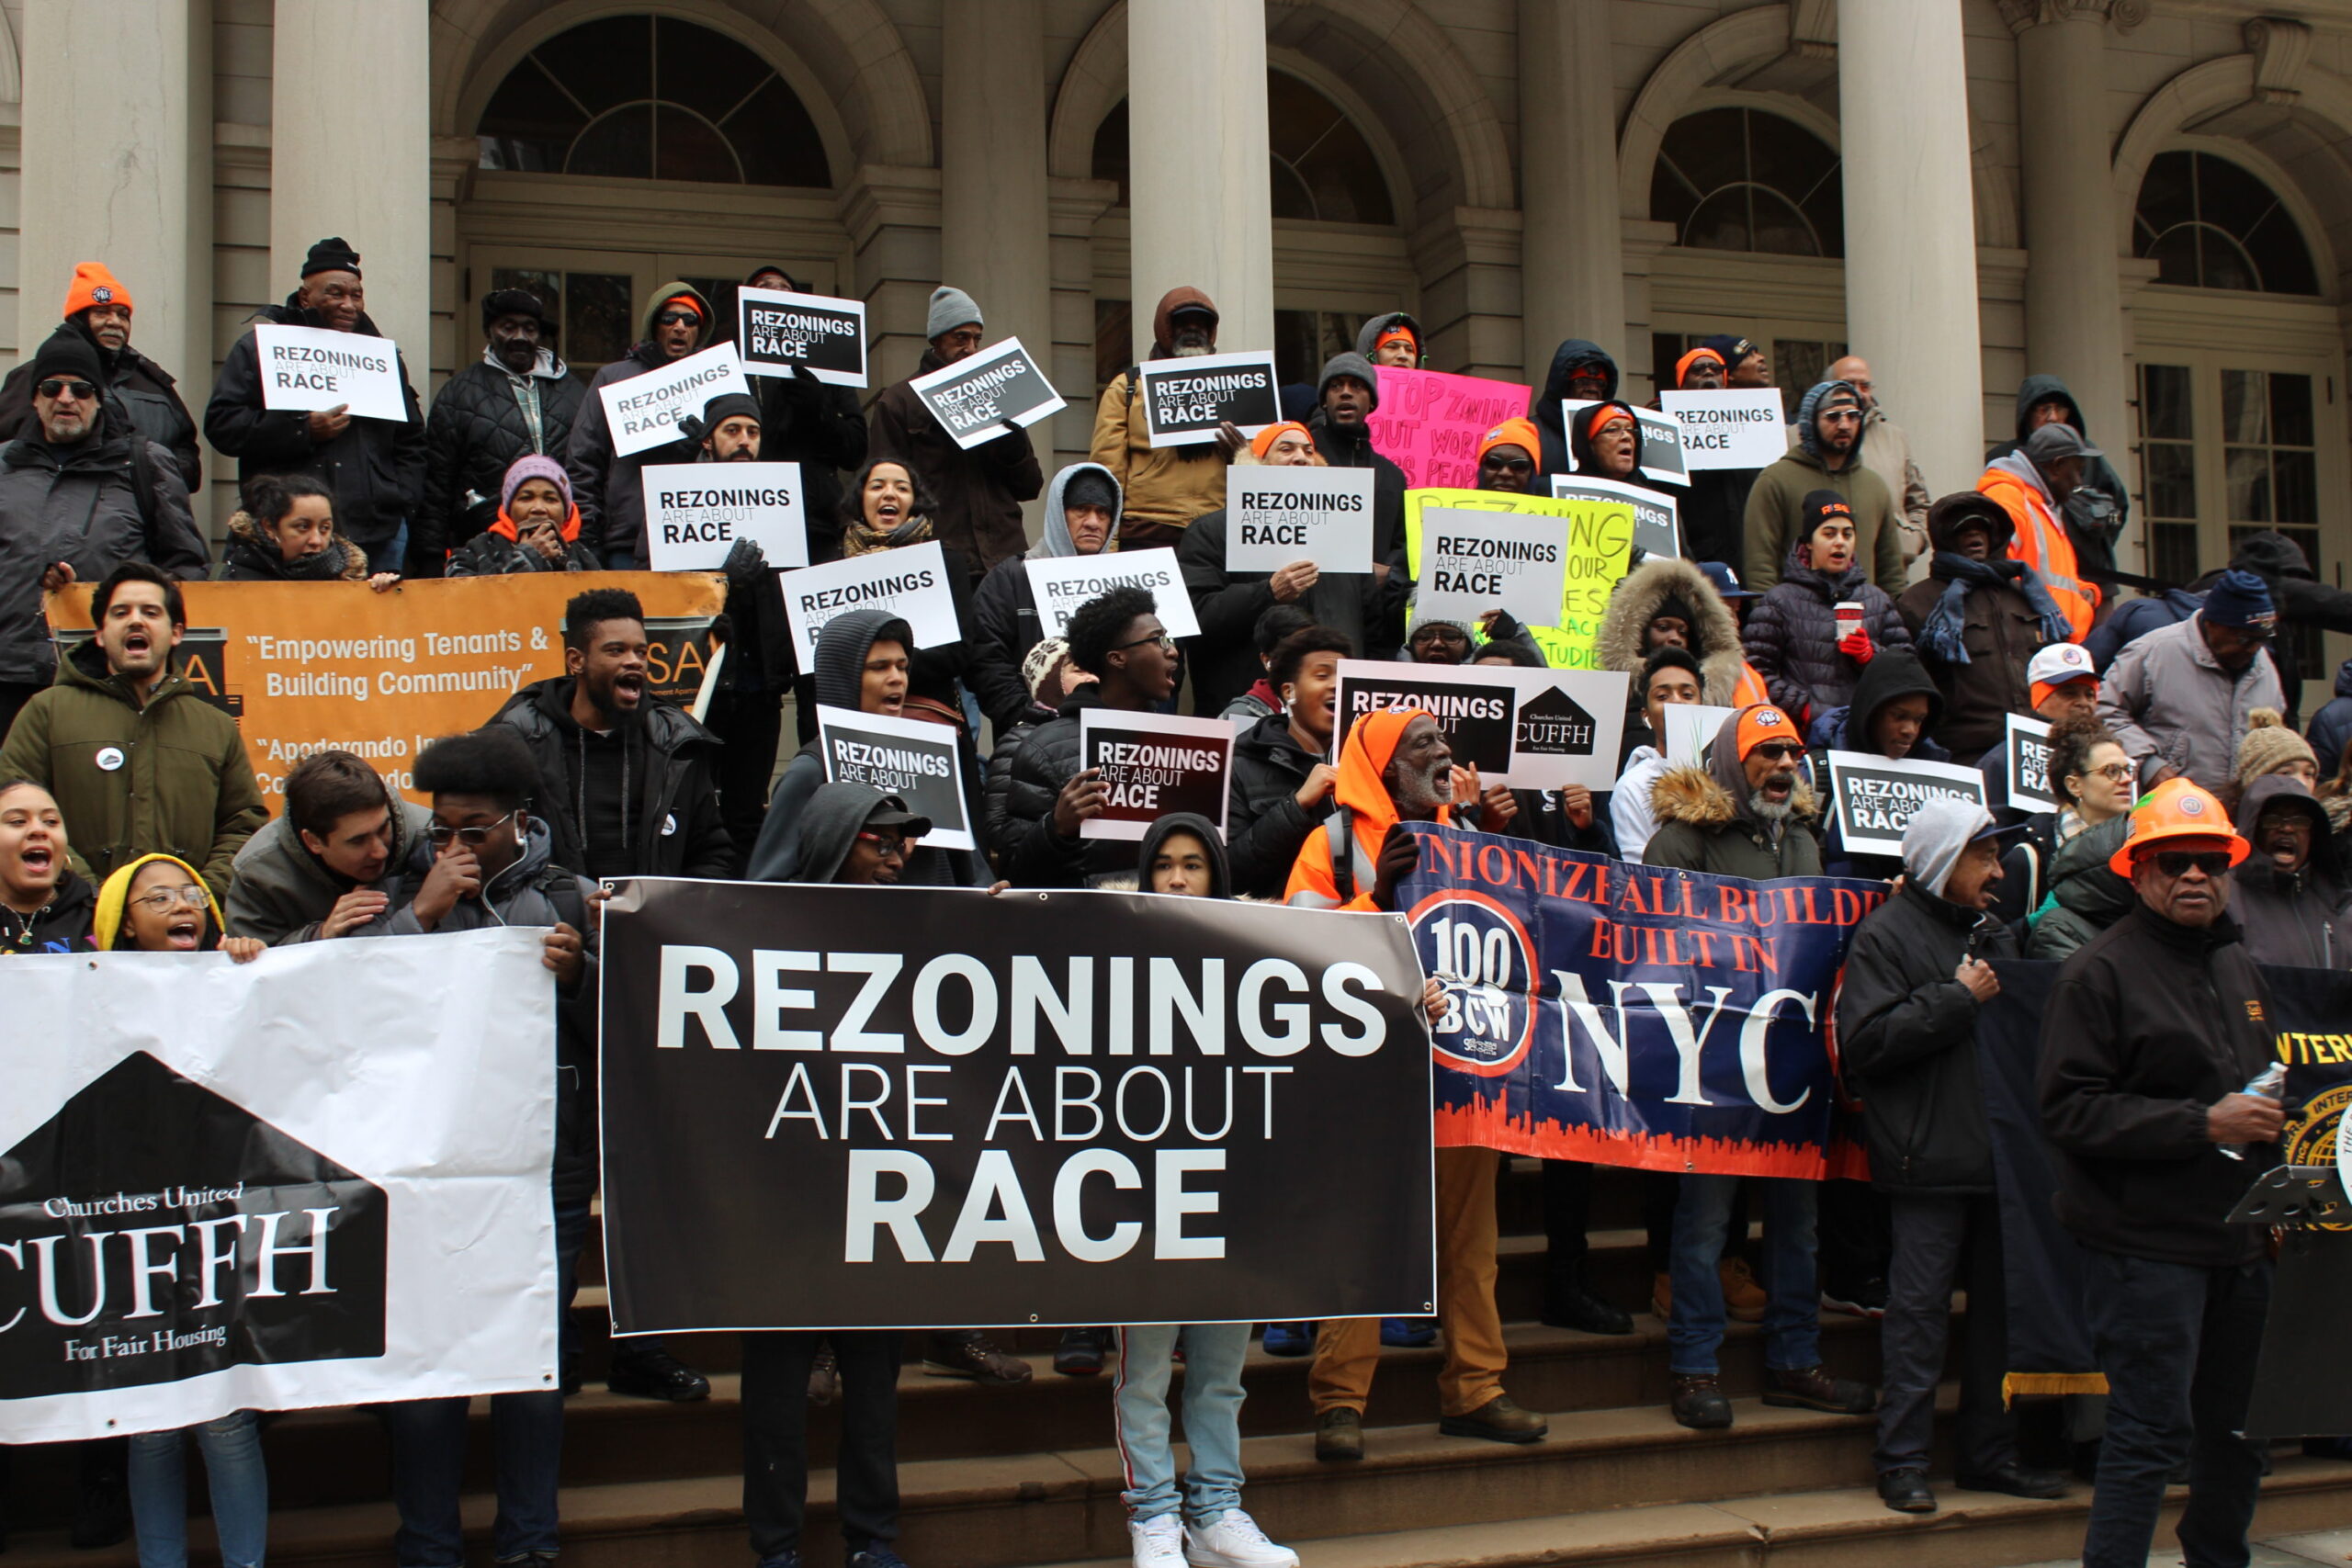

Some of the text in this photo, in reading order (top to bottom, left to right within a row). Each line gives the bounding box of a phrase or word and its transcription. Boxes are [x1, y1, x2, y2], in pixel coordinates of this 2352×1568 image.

[752, 310, 855, 336] REZONINGS
[752, 325, 826, 344] ARE ABOUT
[273, 346, 388, 373] REZONINGS
[752, 336, 808, 358] RACE
[275, 361, 357, 379] ARE ABOUT
[277, 372, 338, 392] RACE
[617, 364, 730, 413] REZONINGS
[932, 359, 1026, 409] REZONINGS
[1155, 373, 1267, 396] REZONINGS
[1381, 371, 1446, 422] TOP
[622, 389, 701, 423] ARE ABOUT
[943, 383, 1007, 418] ARE ABOUT
[1158, 389, 1236, 408] ARE ABOUT
[624, 406, 685, 435] RACE
[949, 400, 1001, 430] RACE
[1159, 403, 1218, 425] RACE
[1675, 409, 1773, 423] REZONINGS
[1705, 423, 1746, 434] ABOUT
[1430, 429, 1482, 461] WOR
[661, 489, 790, 509] REZONINGS
[1241, 492, 1363, 512] REZONINGS
[662, 507, 755, 524] ARE ABOUT
[1241, 511, 1329, 525] ARE ABOUT
[663, 522, 732, 544] RACE
[1241, 525, 1307, 545] RACE
[1437, 536, 1557, 562] REZONINGS
[1435, 556, 1525, 575] ARE ABOUT
[800, 570, 933, 613] REZONINGS
[1046, 571, 1170, 598] REZONINGS
[1434, 571, 1502, 595] RACE
[245, 626, 549, 664] "Empowering Tenants &
[646, 641, 706, 684] SA
[266, 671, 368, 701] Building
[1516, 722, 1590, 744] CUFFH
[834, 739, 950, 778] REZONINGS
[1098, 741, 1221, 773] REZONINGS
[840, 762, 867, 782] ARE
[870, 768, 918, 790] ABOUT
[1098, 764, 1185, 786] ARE ABOUT
[2021, 769, 2053, 794] RA
[1850, 795, 1924, 813] ARE ABO
[1852, 808, 1914, 832] RAC
[1620, 875, 1708, 919] ALL
[1430, 917, 1511, 991] 100
[1589, 917, 1779, 974] BUILT IN
[657, 944, 1387, 1056] REZONINGS
[1436, 992, 1510, 1043] BCW
[1551, 969, 1818, 1114] NYC
[765, 1062, 1295, 1142] ARE ABOUT
[44, 1181, 243, 1218] Churches United
[844, 1148, 1227, 1263] RACE
[64, 1325, 226, 1361] For Fair Housing
